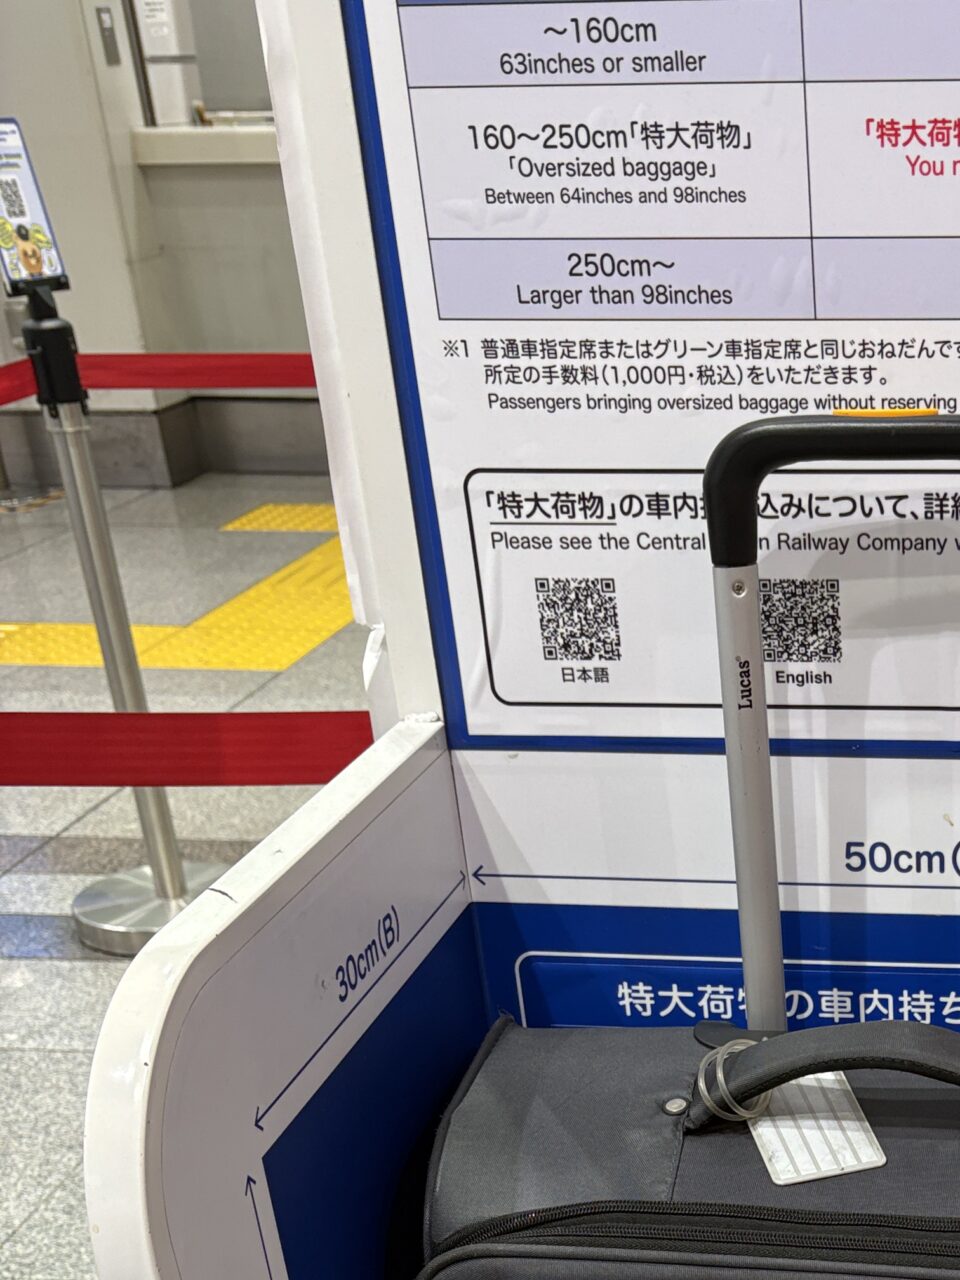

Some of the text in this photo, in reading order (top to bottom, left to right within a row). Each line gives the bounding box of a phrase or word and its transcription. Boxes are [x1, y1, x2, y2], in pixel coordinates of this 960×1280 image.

[499, 49, 708, 76] 63inches or smaller
[904, 154, 946, 177] You
[484, 185, 748, 205] Between 64inches and 98inches
[516, 283, 734, 311] Larger than 98inches
[487, 391, 583, 414] Passengers
[585, 392, 653, 414] bringing
[656, 392, 734, 411] oversized
[737, 393, 810, 414] baggage
[812, 392, 877, 411] without
[880, 392, 958, 414] reserving
[490, 530, 706, 551] Please see the Central
[776, 531, 850, 556] Railway
[856, 531, 949, 556] Company
[560, 665, 610, 684] 日本語
[775, 670, 833, 687] English
